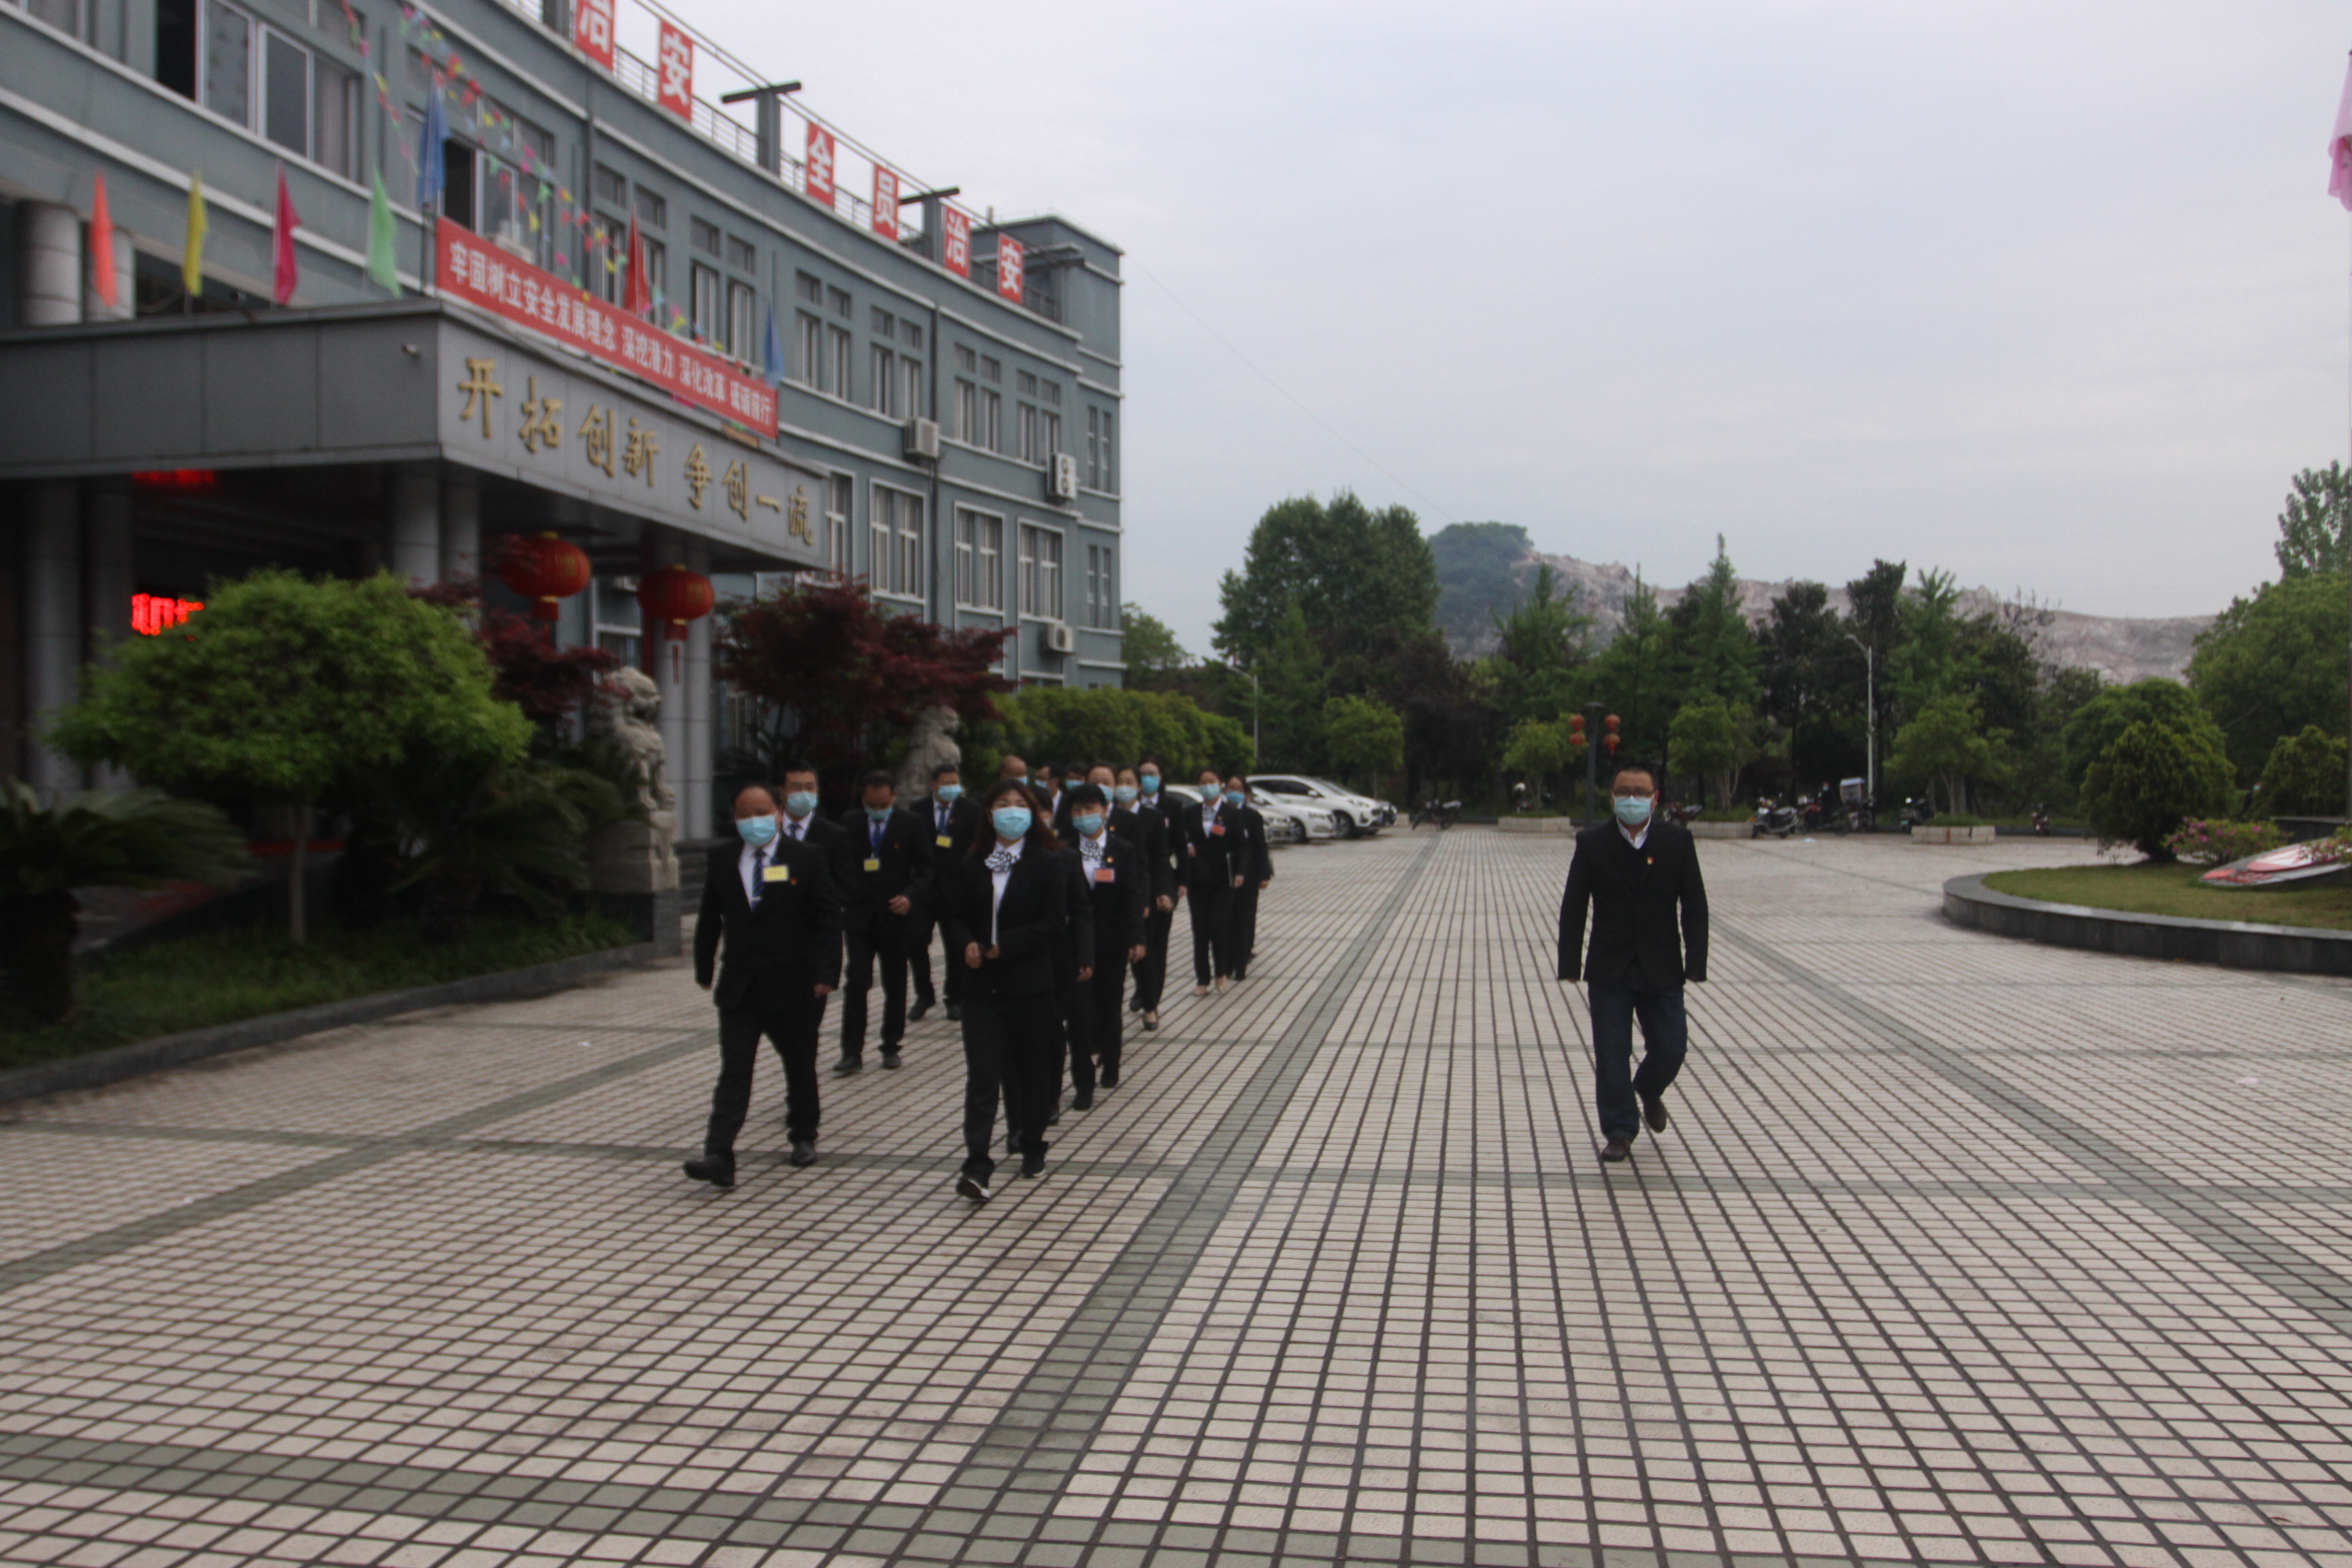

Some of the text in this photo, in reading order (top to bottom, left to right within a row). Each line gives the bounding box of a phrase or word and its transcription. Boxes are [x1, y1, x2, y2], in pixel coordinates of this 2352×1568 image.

[807, 133, 1022, 295] 全员治安
[450, 240, 616, 352] 牢固树立安全发展理念
[679, 354, 725, 403] 深化改革
[459, 357, 814, 545] 开拓创新 争创一流
